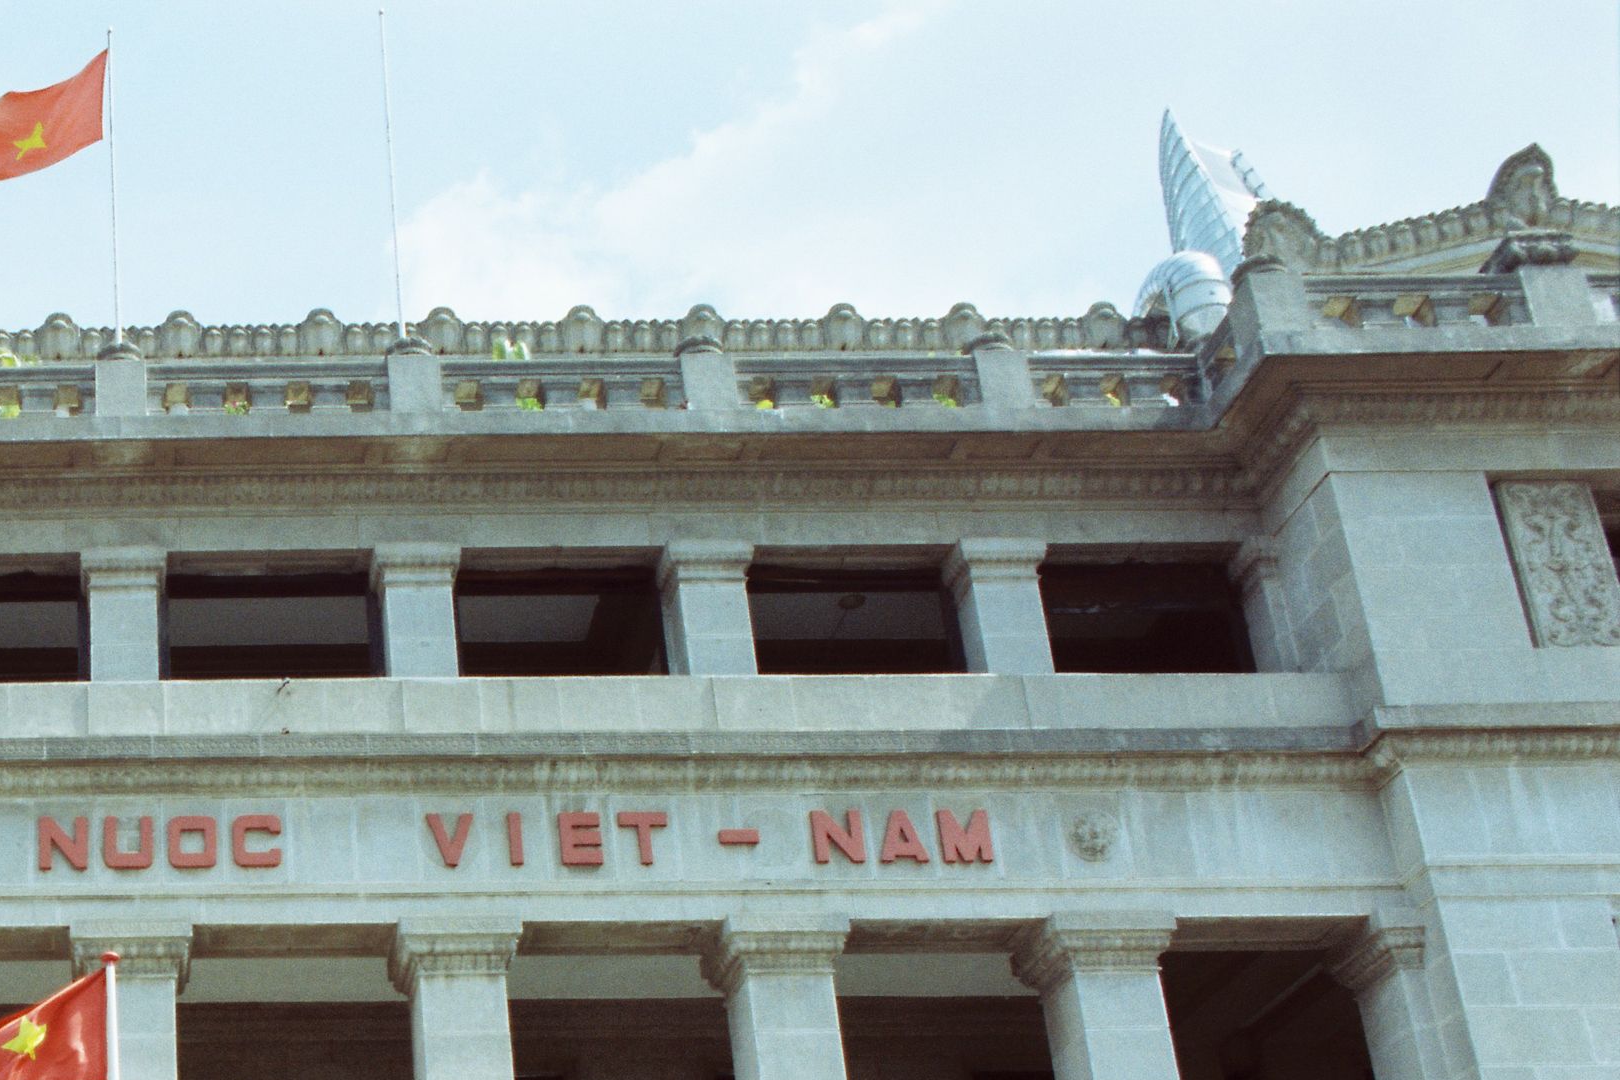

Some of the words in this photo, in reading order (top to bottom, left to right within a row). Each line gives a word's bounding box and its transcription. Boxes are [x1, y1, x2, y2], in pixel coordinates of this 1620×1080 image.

[38, 814, 281, 871] NUOC
[425, 812, 667, 867] VIET
[810, 810, 994, 864] NAM
